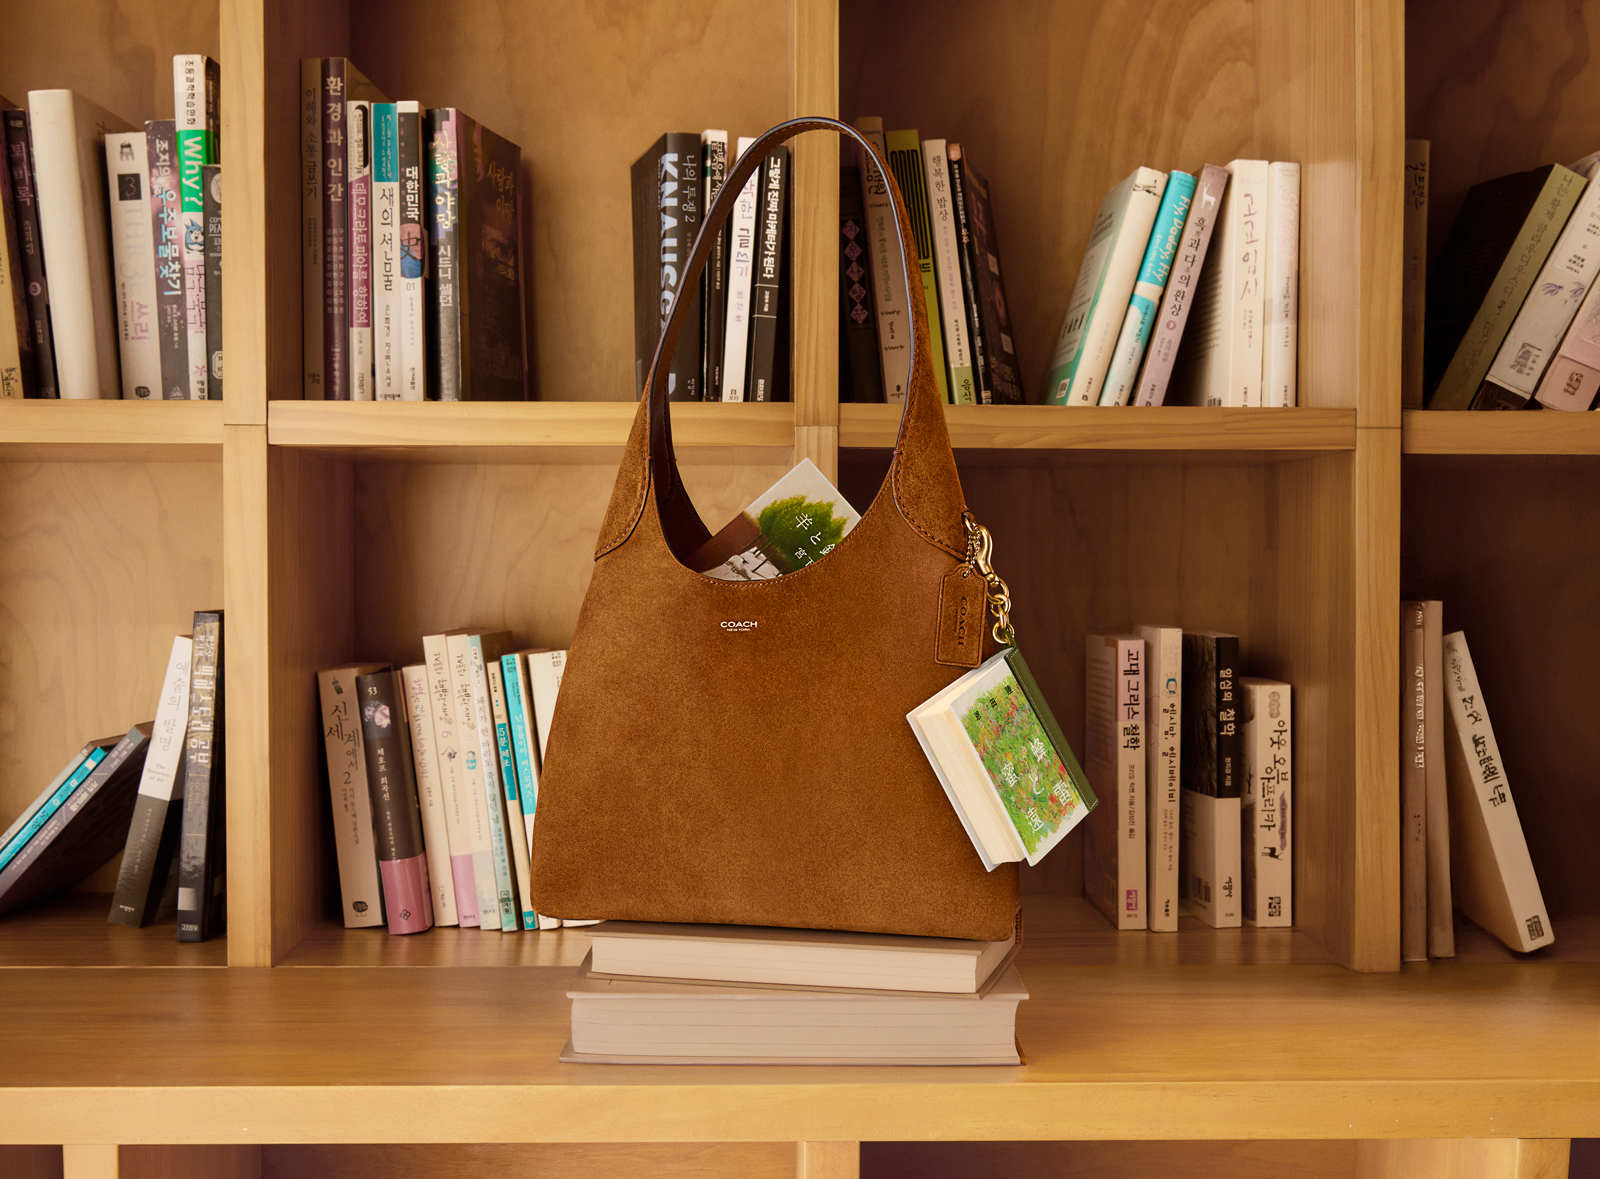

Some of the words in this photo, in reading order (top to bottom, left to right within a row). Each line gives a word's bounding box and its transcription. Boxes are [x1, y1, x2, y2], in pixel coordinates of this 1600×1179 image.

[306, 88, 317, 126] 이해와
[326, 77, 343, 146] 환경과
[155, 139, 171, 186] 조지의
[182, 135, 203, 206] Why?
[681, 154, 697, 181] 나의
[711, 141, 725, 181] 끝맺음에
[768, 157, 781, 189] 그렇게
[931, 155, 946, 192] 행복한
[306, 161, 318, 200] 글쓰기
[327, 158, 344, 201] 인간
[406, 166, 419, 220] 대한민국
[379, 187, 394, 228] 새의
[436, 193, 452, 230] 야망
[681, 186, 696, 213] 투쟁
[766, 190, 779, 212] 진짜
[936, 197, 949, 221] 밥상
[1171, 194, 1191, 217] Fly,
[351, 183, 368, 281] 데모크라토피아를
[764, 213, 778, 256] 마케터가
[1161, 217, 1186, 260] Daddy,
[1278, 186, 1299, 260] SPEED
[157, 187, 182, 297] 우주보물찾기
[400, 231, 421, 262] 史
[660, 152, 679, 333] KNAUSG
[736, 227, 751, 277] 글쓰기
[1240, 193, 1259, 300] 고교입시
[380, 232, 394, 291] 선물
[438, 246, 451, 279] 시드니
[763, 257, 775, 279] 된다
[1152, 261, 1171, 283] Fly
[353, 285, 369, 324] 향하여
[1169, 289, 1186, 317] 환상
[130, 301, 151, 341] 쓰리
[961, 379, 972, 402] 음식
[958, 597, 968, 646] COACH
[1123, 650, 1141, 676] 고대
[168, 661, 189, 711] 예술의
[368, 686, 378, 695] 53
[1123, 679, 1140, 720] 그리스
[1219, 668, 1233, 702] 일심의
[476, 696, 487, 724] 돼지가
[1163, 703, 1176, 740] 헬시맘,
[1220, 708, 1235, 737] 철학
[159, 718, 176, 752] 발명
[481, 727, 489, 737] 한
[499, 728, 508, 746] 5분
[1123, 723, 1140, 751] 철학
[1270, 719, 1287, 750] 아웃
[189, 737, 210, 764] 공부
[87, 780, 99, 793] 가가
[343, 771, 352, 785] 2
[1028, 772, 1045, 795] と
[1162, 747, 1176, 802] 헬시베이비
[1274, 753, 1289, 785] 오브
[1260, 766, 1275, 831] 아프리카
[1223, 876, 1233, 898] 서광사
